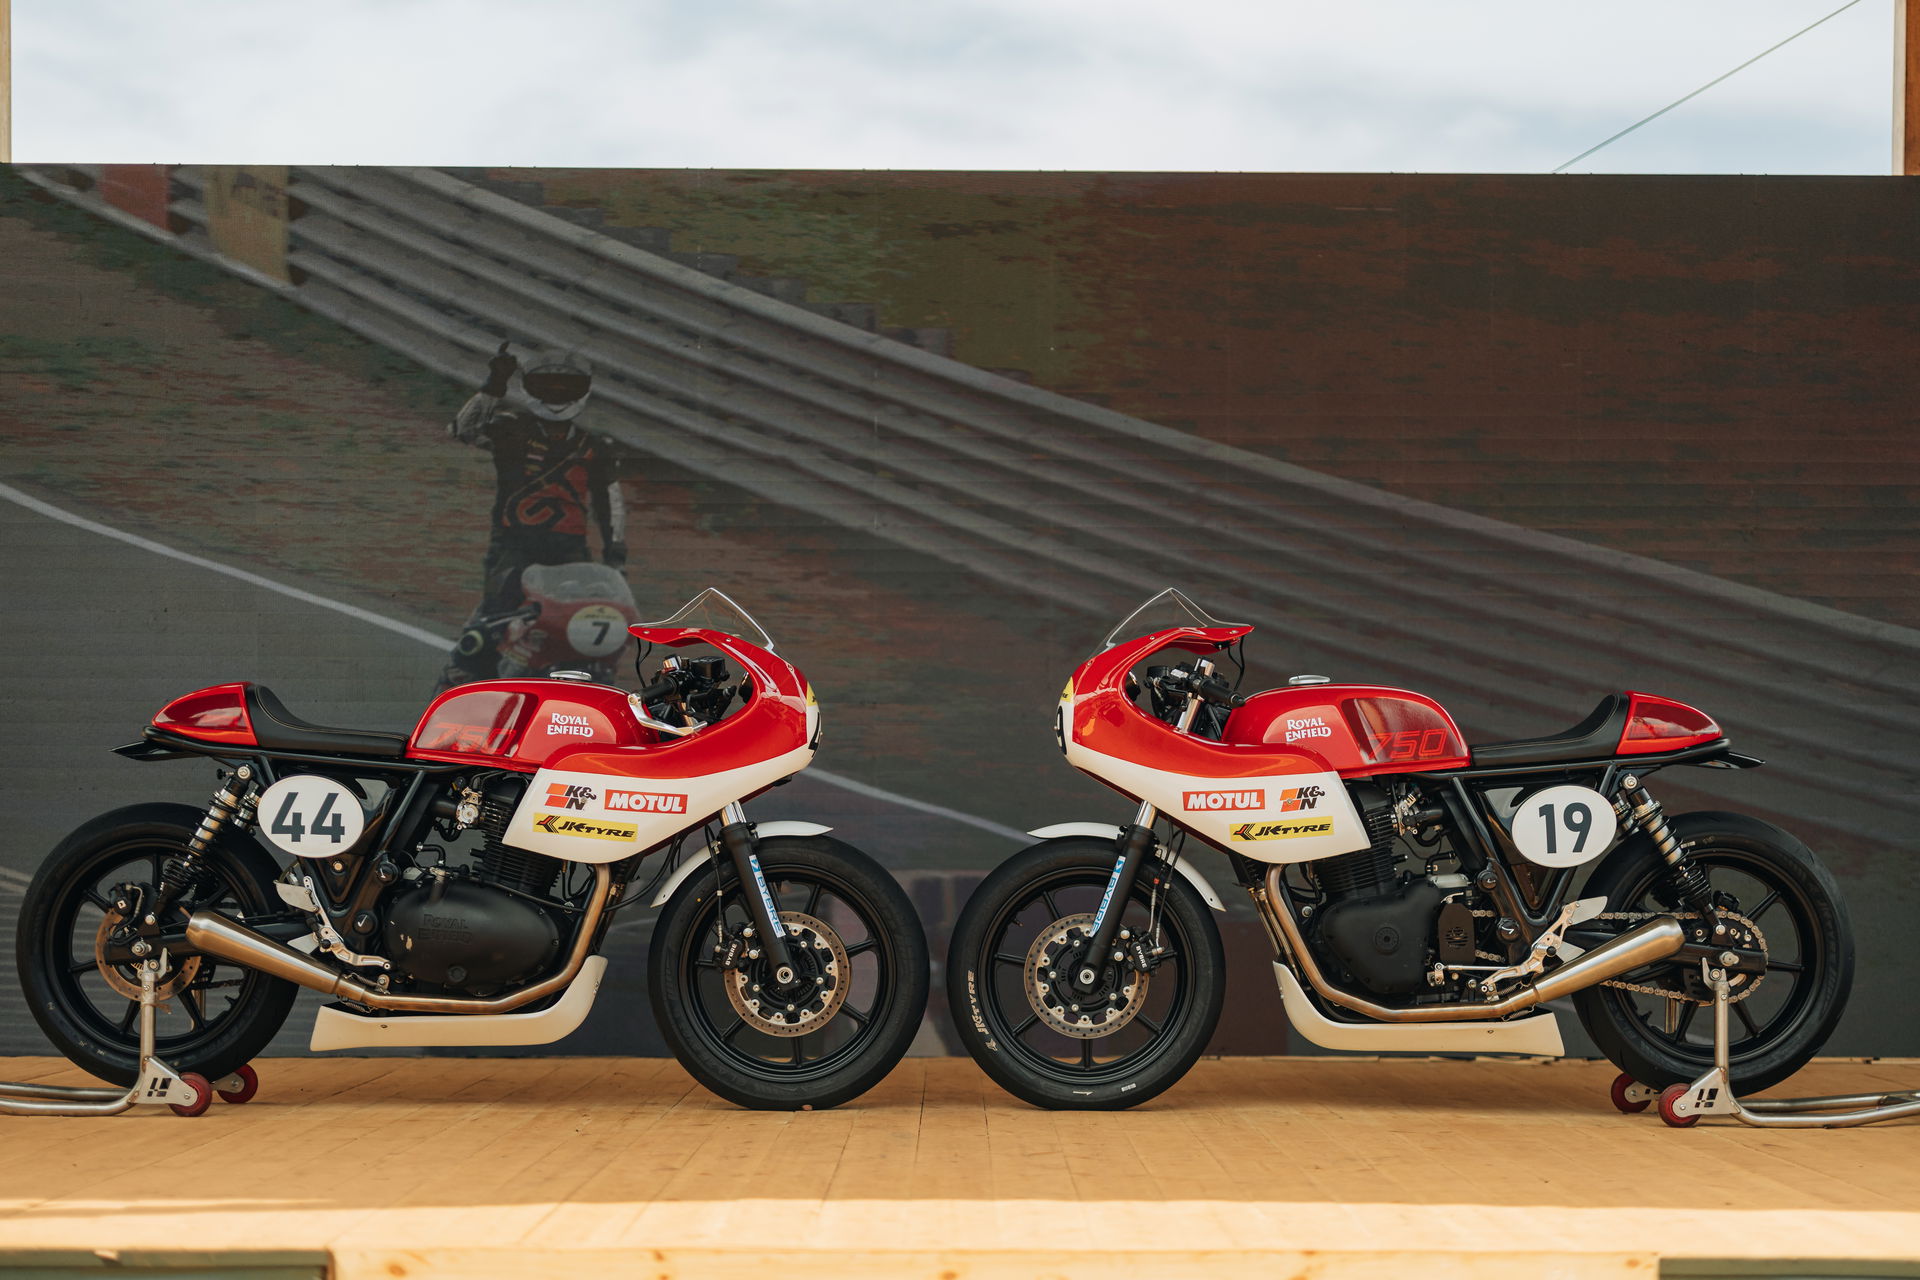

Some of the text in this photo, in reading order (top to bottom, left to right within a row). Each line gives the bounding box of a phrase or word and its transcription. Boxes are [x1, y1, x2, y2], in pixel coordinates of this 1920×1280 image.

[592, 621, 610, 646] 7
[551, 713, 590, 726] ROYAL
[1286, 717, 1326, 730] ROYAL
[547, 724, 594, 738] ENFIELD
[1285, 726, 1332, 742] ENFIELD
[1368, 728, 1449, 760] 750
[608, 792, 683, 812] MOTUL
[1187, 791, 1262, 809] MOTUL
[271, 791, 346, 844] 44
[1538, 801, 1593, 854] 19
[757, 876, 783, 933] BYBRE
